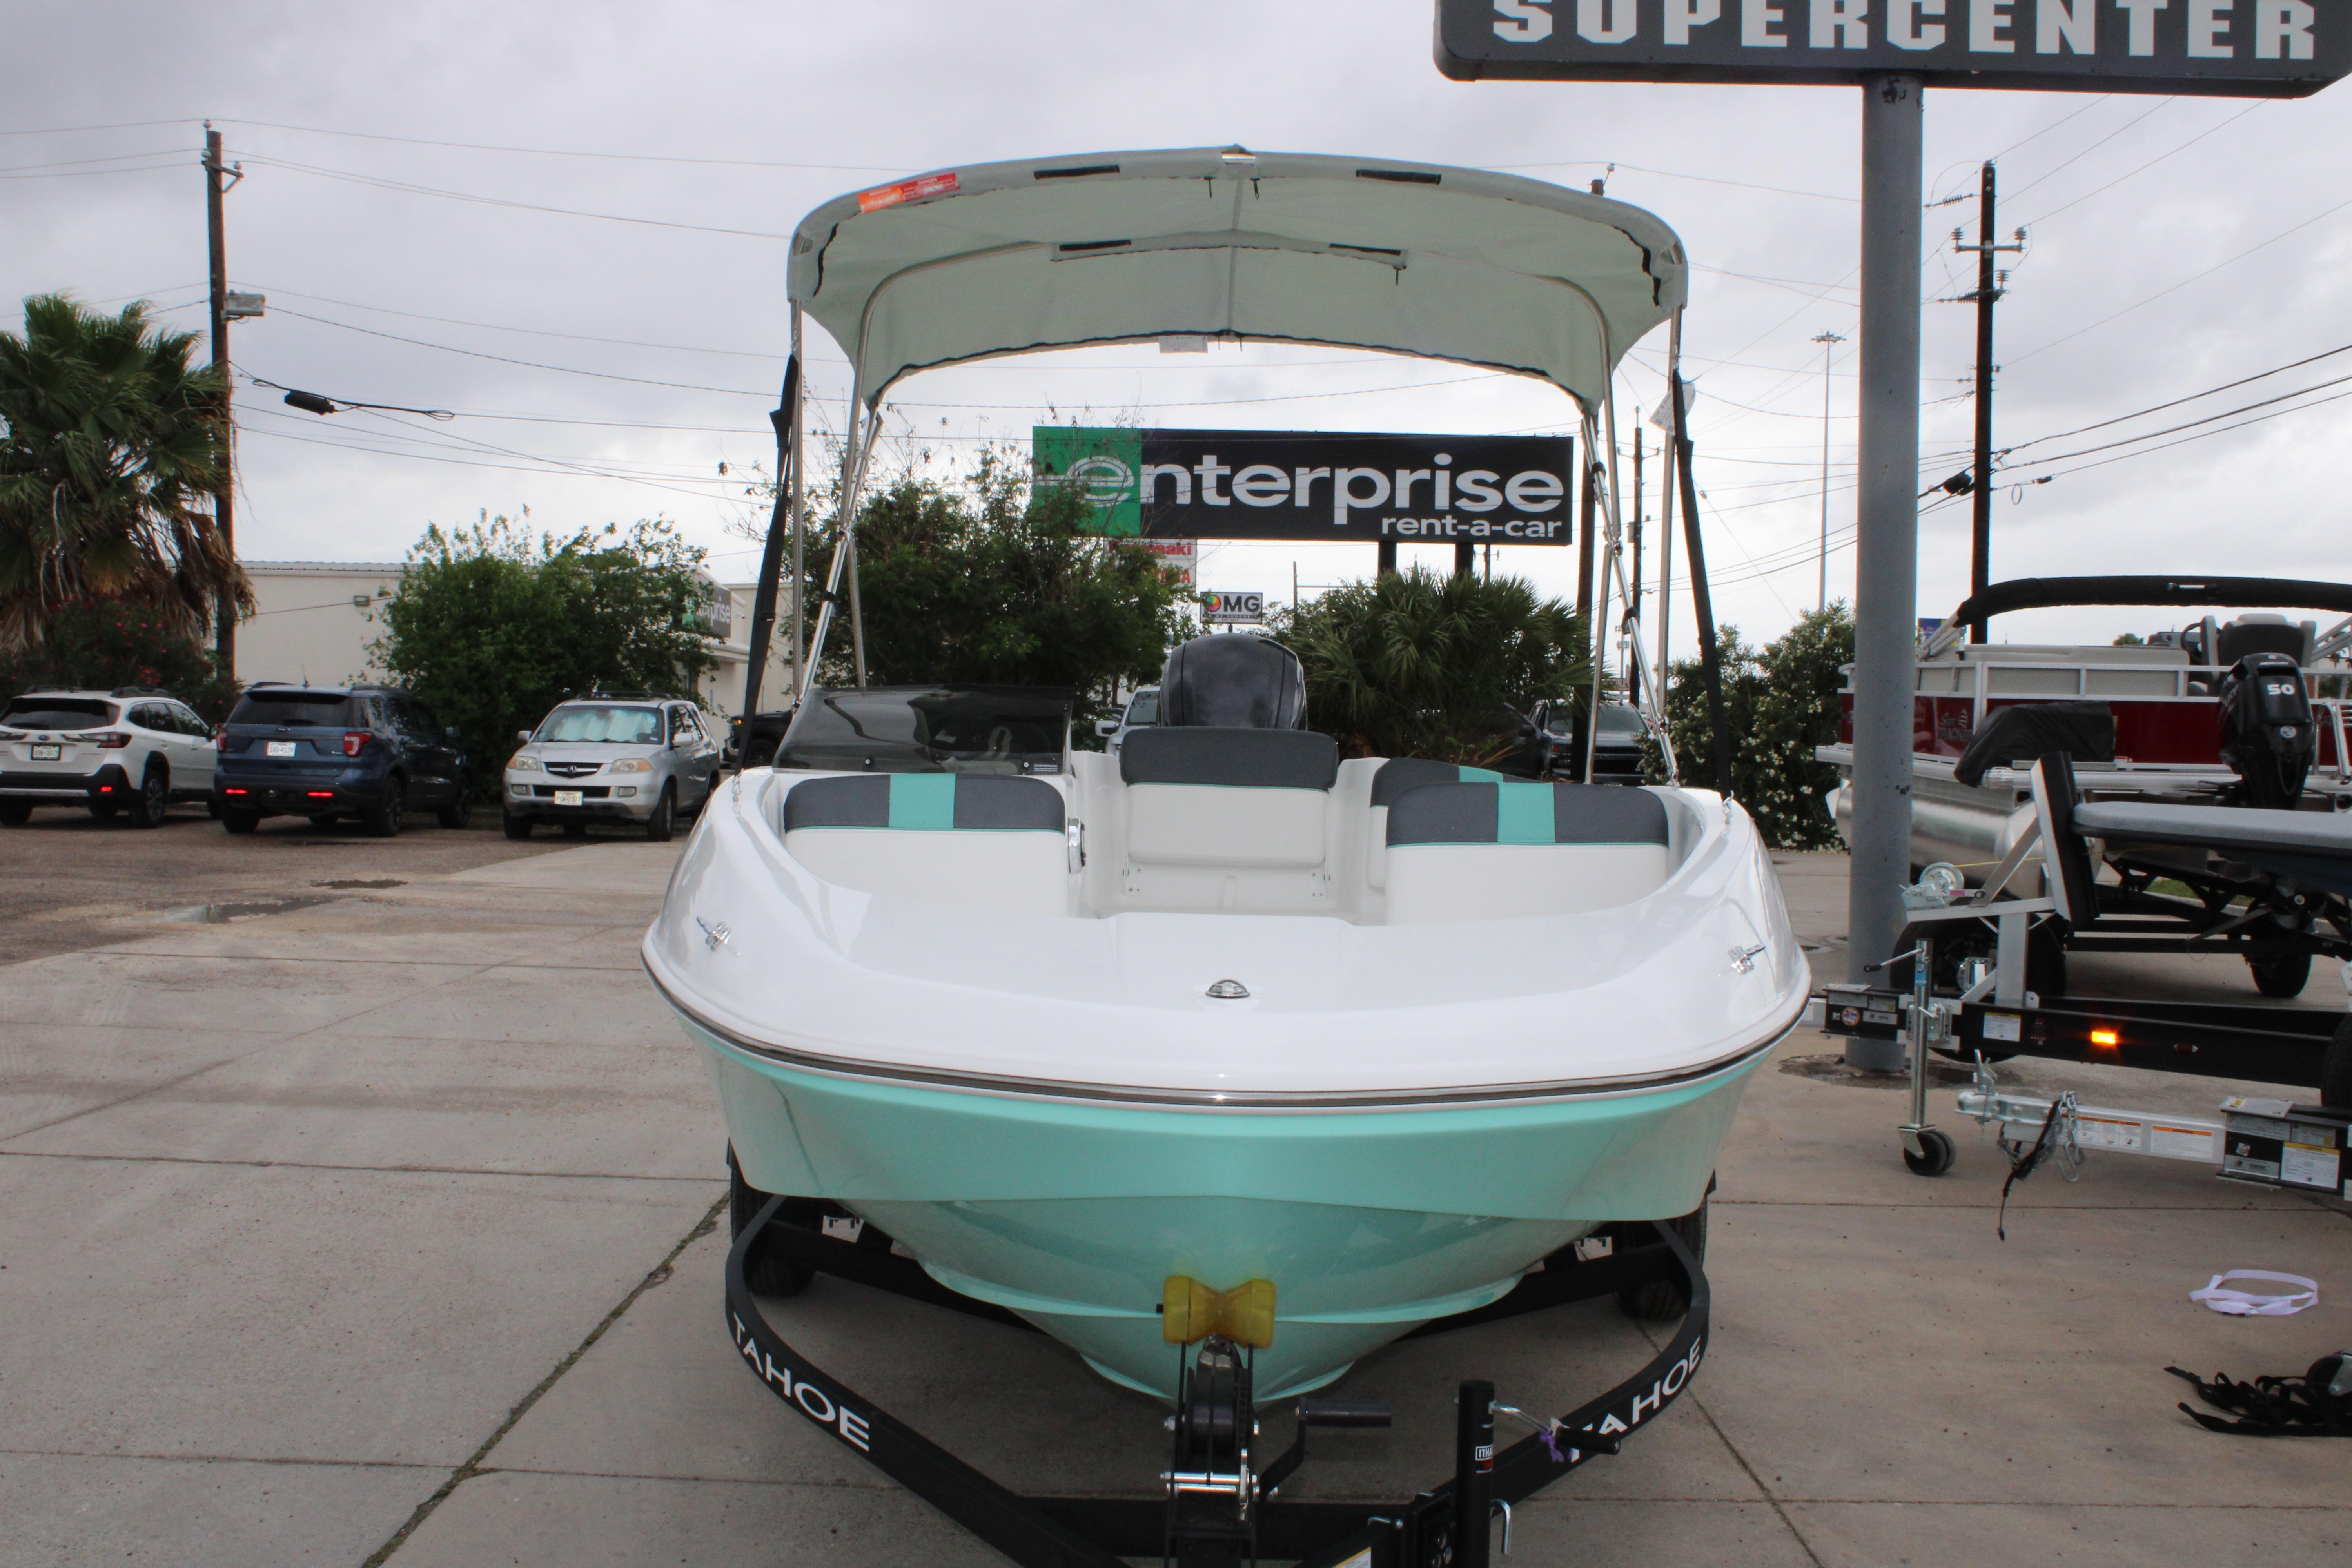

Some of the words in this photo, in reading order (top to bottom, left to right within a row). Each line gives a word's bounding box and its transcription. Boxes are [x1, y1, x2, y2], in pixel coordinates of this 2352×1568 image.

[1493, 0, 2314, 60] SUPERCENTER
[1037, 453, 1564, 524] enterprise
[1381, 515, 1562, 537] rent-a-car
[2267, 684, 2295, 695] 50
[733, 1312, 869, 1452] TAHOE
